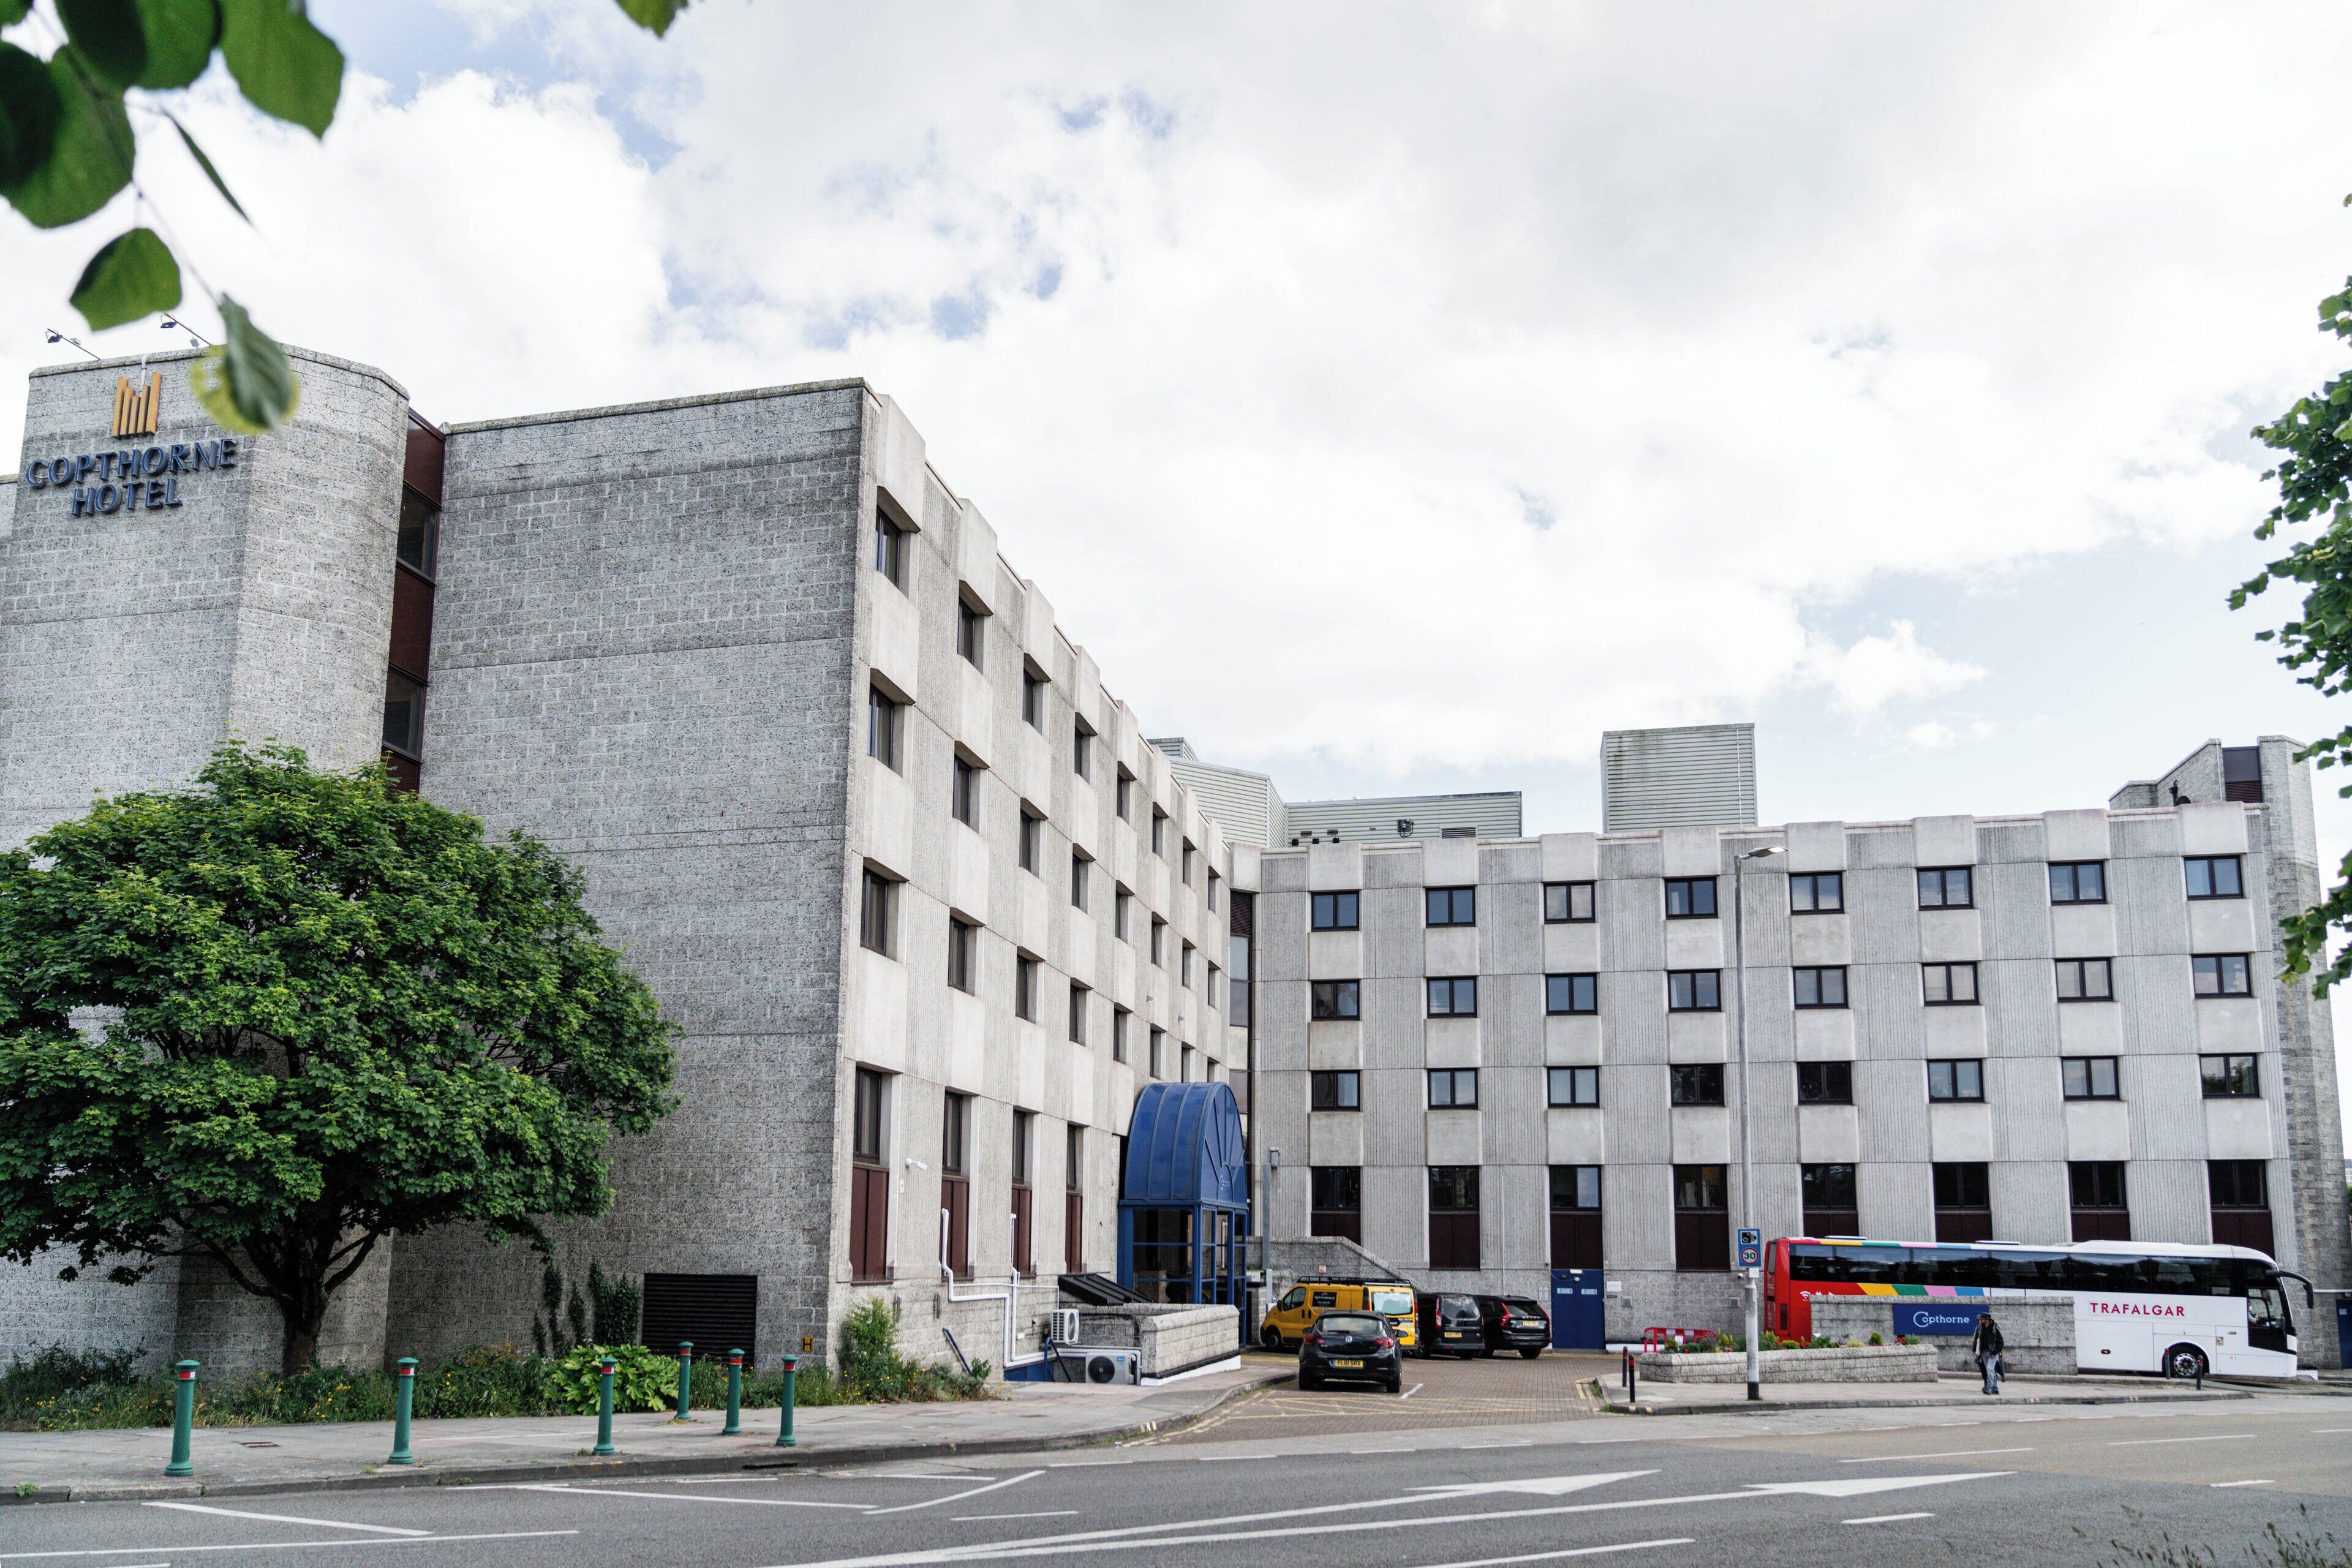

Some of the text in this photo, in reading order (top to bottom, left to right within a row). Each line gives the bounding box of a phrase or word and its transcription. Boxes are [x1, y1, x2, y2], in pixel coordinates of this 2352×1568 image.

[26, 439, 237, 488] COPTHORNE
[70, 478, 183, 517] HOTEL
[2090, 1302, 2185, 1317] TRAFALGAR
[1913, 1311, 1970, 1328] Copthorne
[802, 1338, 812, 1351] H
